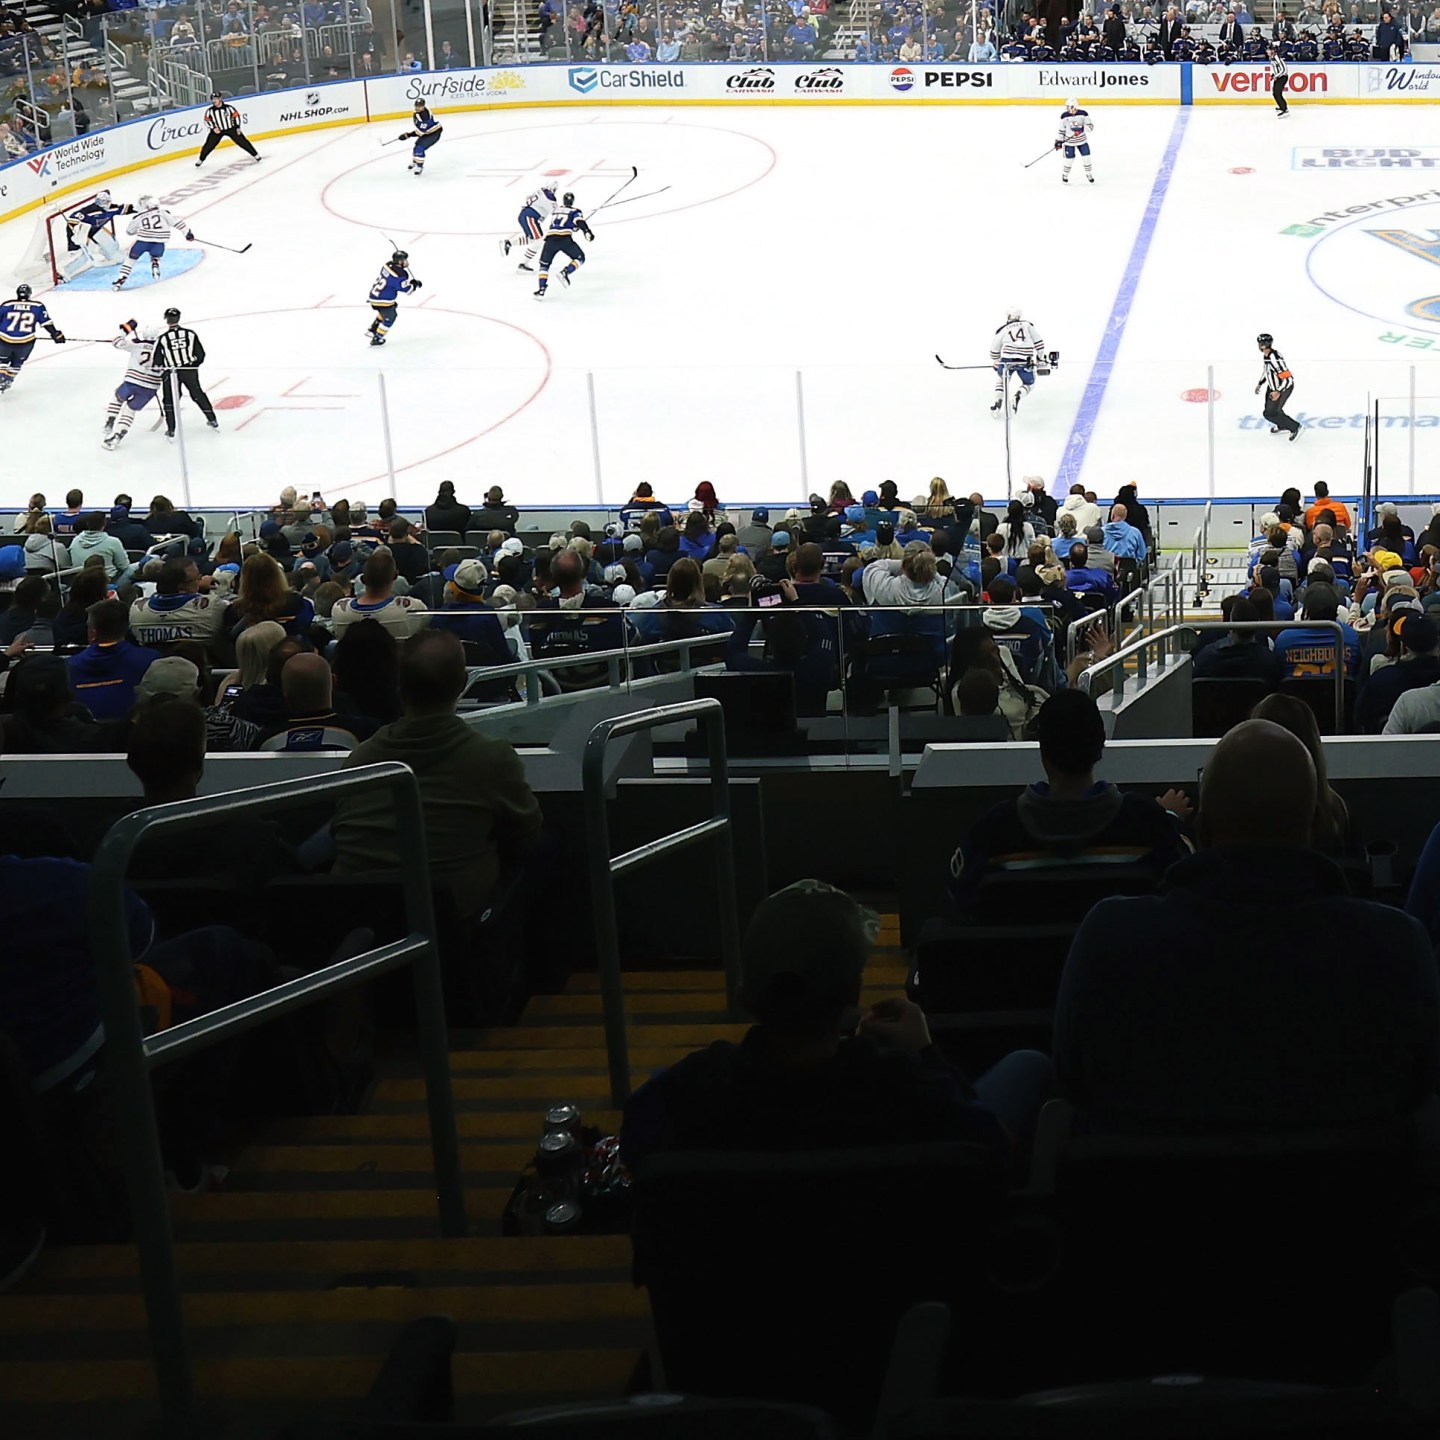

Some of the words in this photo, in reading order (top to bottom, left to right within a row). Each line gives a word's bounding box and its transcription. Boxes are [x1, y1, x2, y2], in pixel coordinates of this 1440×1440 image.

[600, 70, 684, 89] CarShield
[726, 72, 776, 89] Club
[795, 72, 844, 89] Club
[925, 71, 993, 88] PEPSI
[1211, 66, 1328, 92] verion
[406, 77, 485, 100] Surfside
[147, 118, 202, 150] Circa
[54, 143, 79, 159] World
[81, 137, 104, 149] Wide
[1322, 148, 1422, 158] BUD
[56, 149, 104, 171] Technology
[1301, 158, 1440, 169] LIGHT
[142, 214, 162, 229] 92
[6, 311, 36, 333] 72
[171, 339, 187, 350] 55
[139, 626, 193, 642] THOMAS
[1285, 646, 1352, 663] NEIGHBOUS
